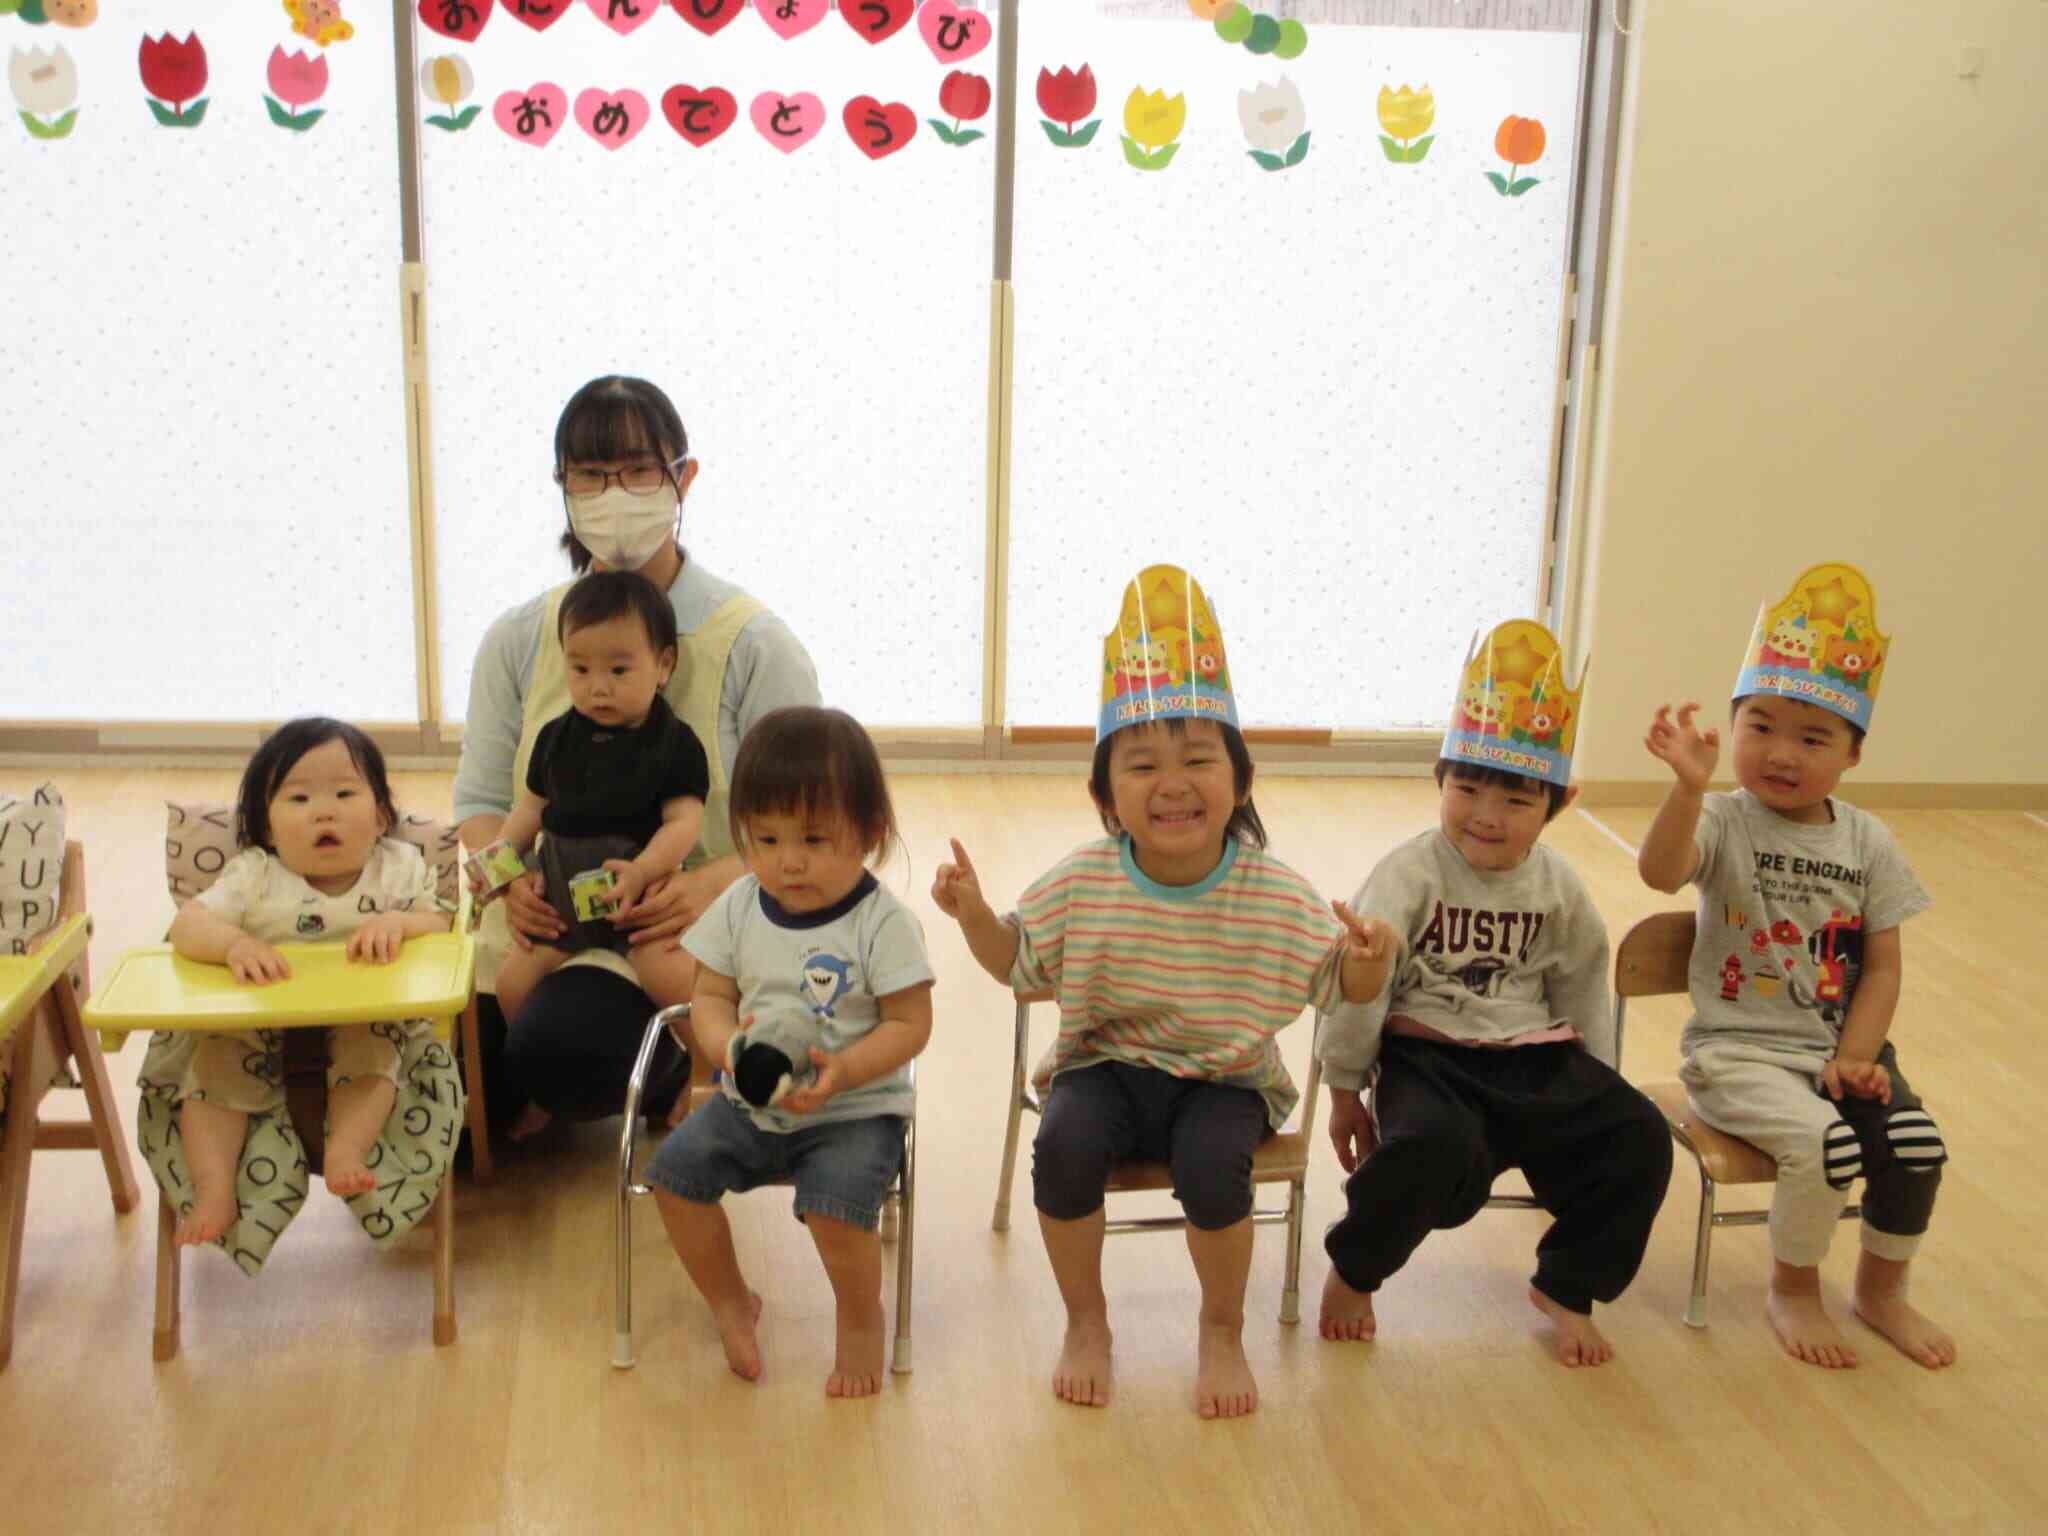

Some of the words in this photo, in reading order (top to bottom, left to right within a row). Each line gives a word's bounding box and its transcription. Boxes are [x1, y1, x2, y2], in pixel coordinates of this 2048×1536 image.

[511, 96, 894, 148] おめでとう
[1754, 851, 1786, 871] RE
